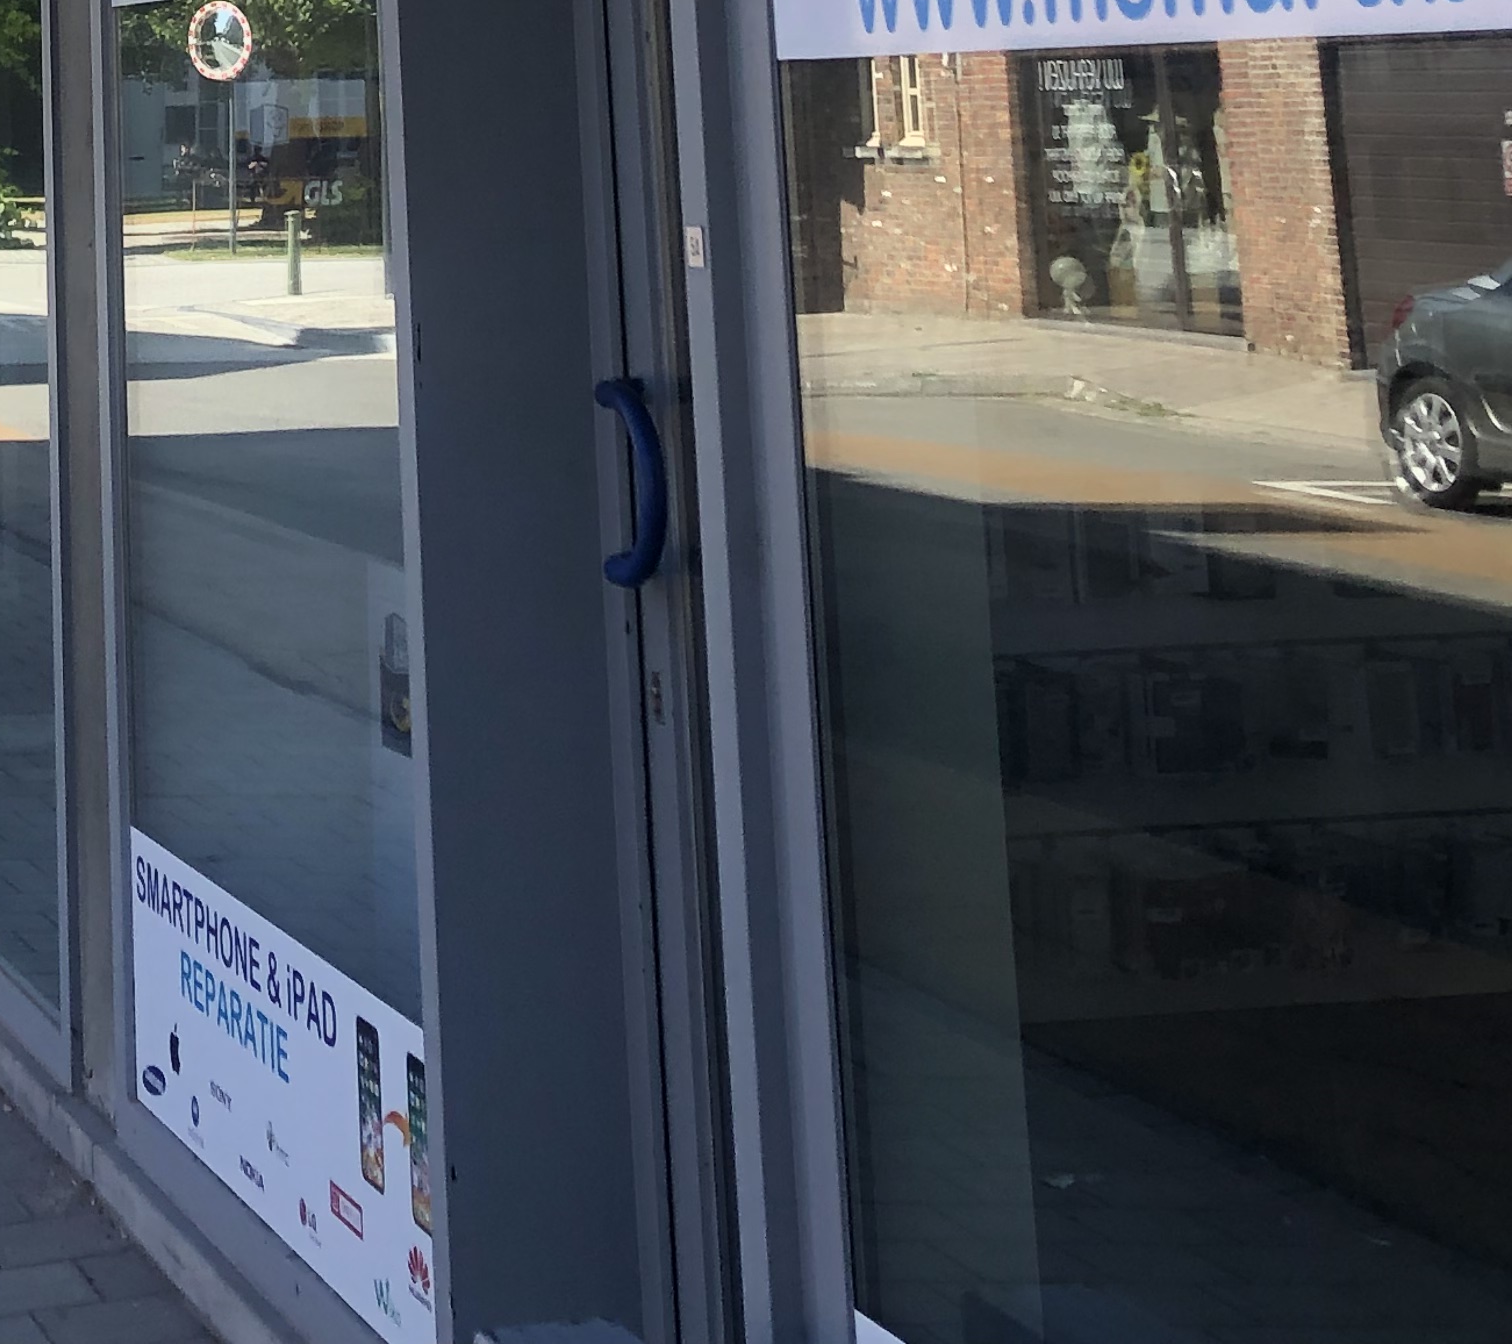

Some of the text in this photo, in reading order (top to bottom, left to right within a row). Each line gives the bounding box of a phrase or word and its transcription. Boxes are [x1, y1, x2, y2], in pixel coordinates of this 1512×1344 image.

[303, 180, 344, 206] GLS
[136, 855, 337, 1048] SMARTPHONE & iPAD
[179, 950, 290, 1084] REPARATIE
